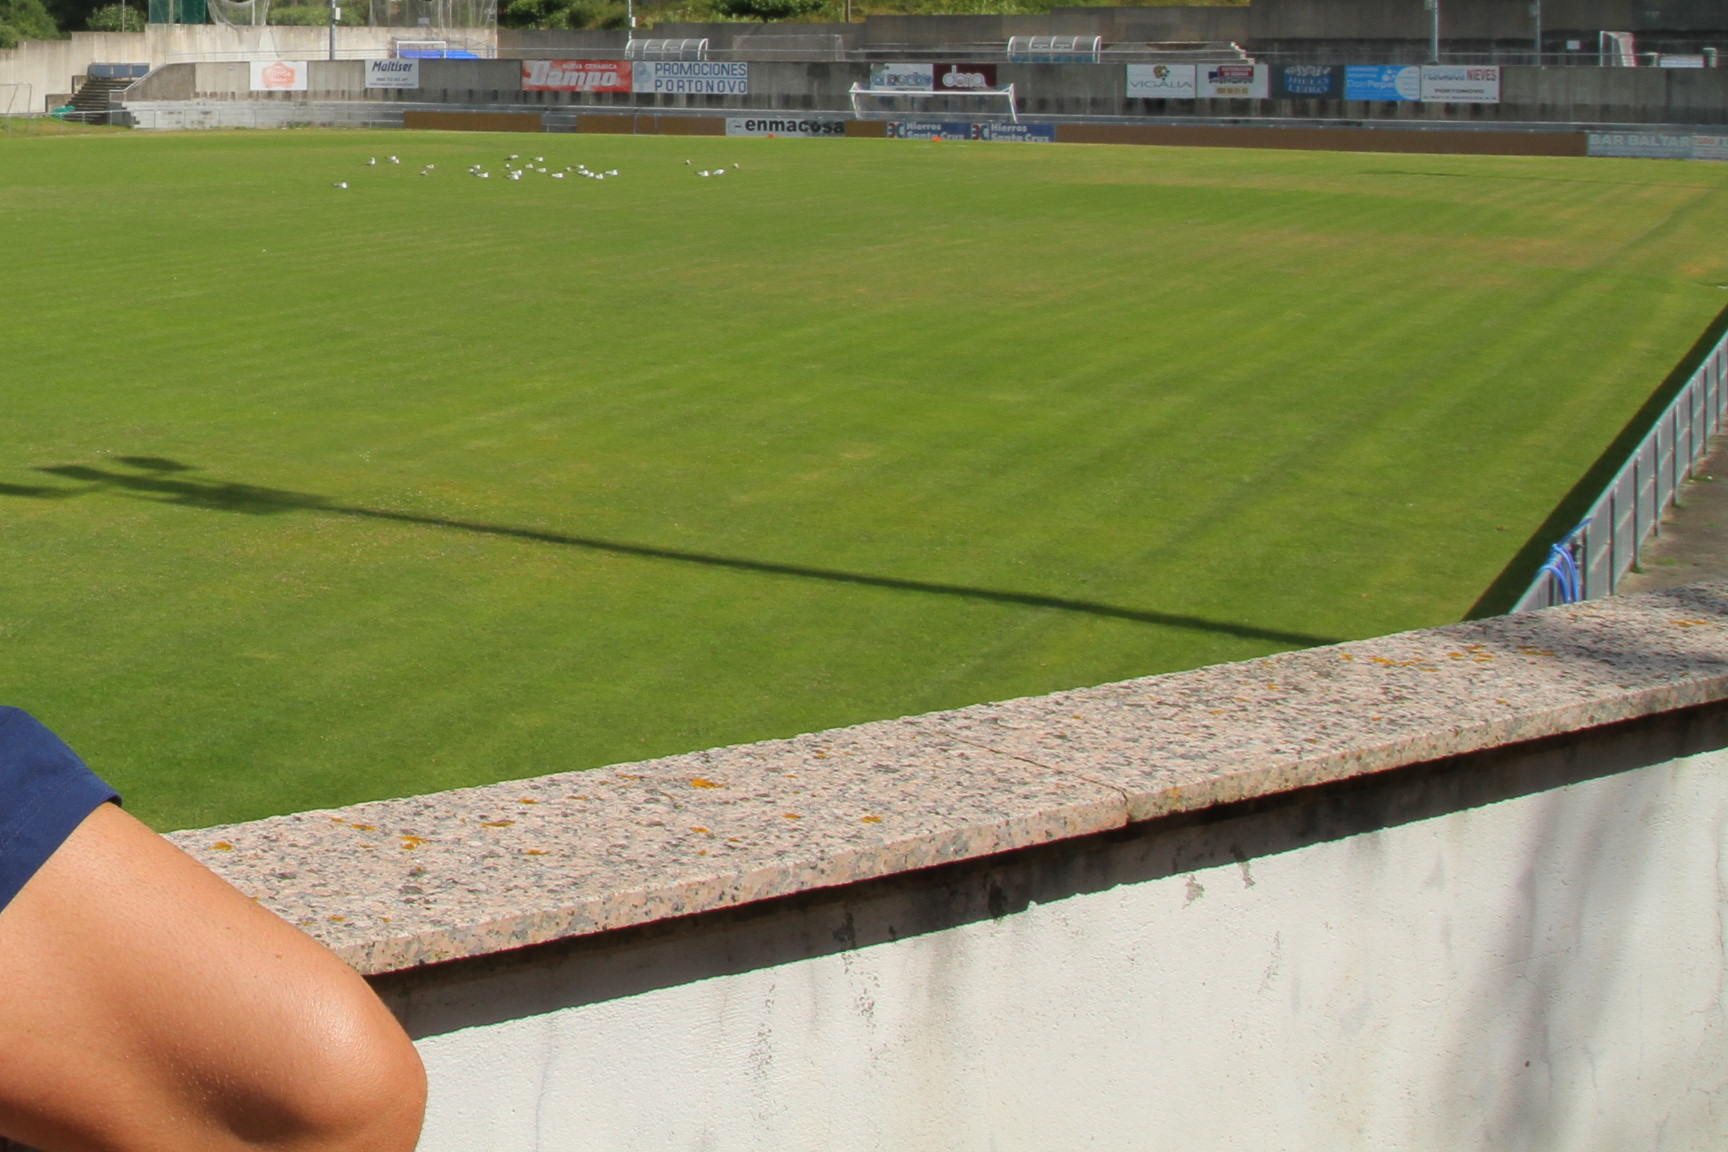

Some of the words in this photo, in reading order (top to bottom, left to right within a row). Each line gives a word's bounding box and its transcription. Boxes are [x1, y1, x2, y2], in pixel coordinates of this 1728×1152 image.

[655, 62, 747, 76] PROMOCIONES
[654, 79, 747, 93] PORTONOVO
[1130, 80, 1192, 89] VIGALIA
[744, 118, 845, 134] enmacosa
[1589, 134, 1624, 145] BAR
